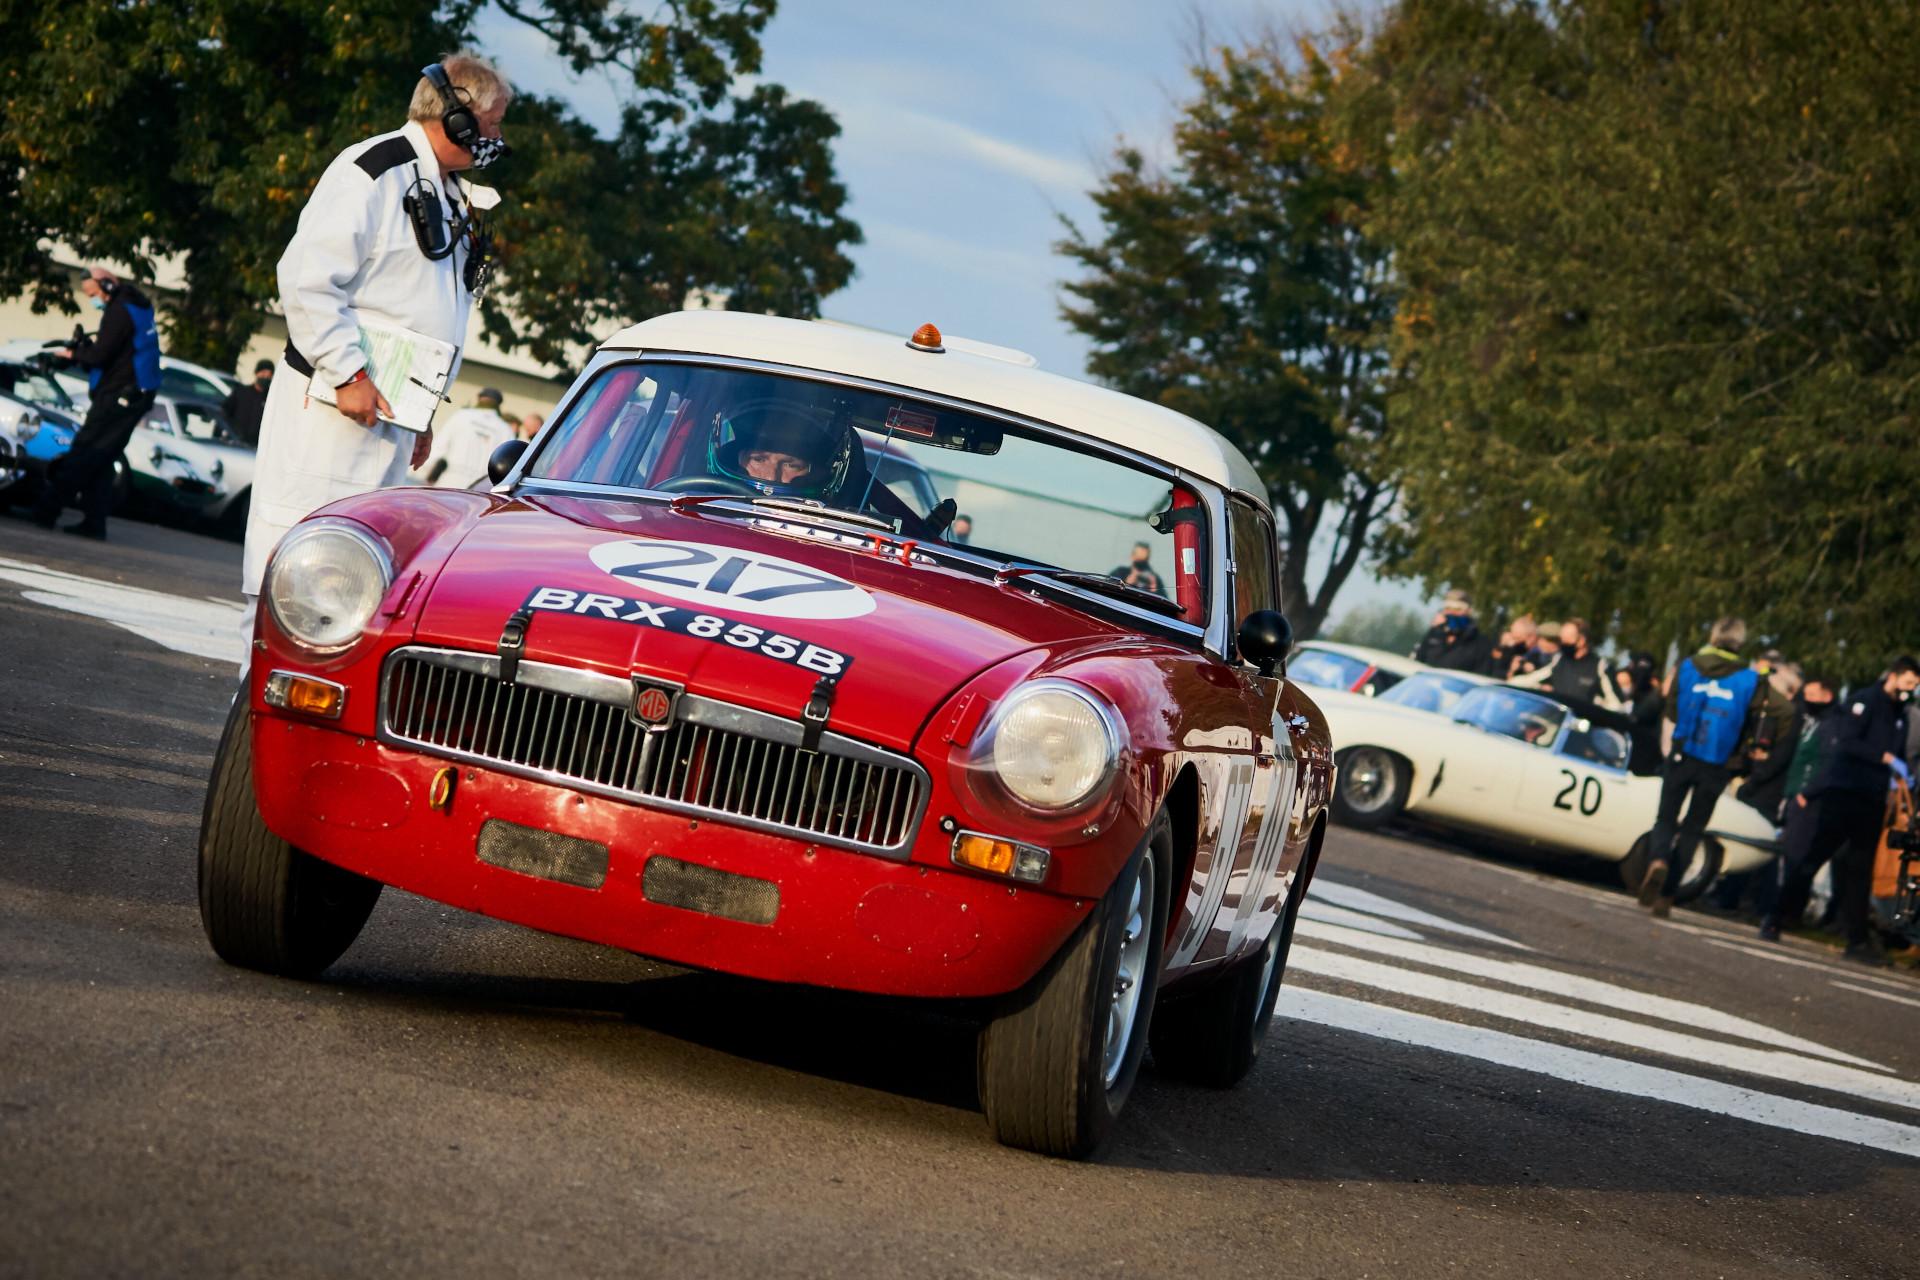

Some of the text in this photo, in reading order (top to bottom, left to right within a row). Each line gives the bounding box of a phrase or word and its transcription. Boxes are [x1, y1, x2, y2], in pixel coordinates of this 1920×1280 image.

[609, 543, 855, 602] 217
[529, 588, 847, 676] BRX 855B
[639, 691, 667, 719] MG
[1553, 770, 1603, 816] 20
